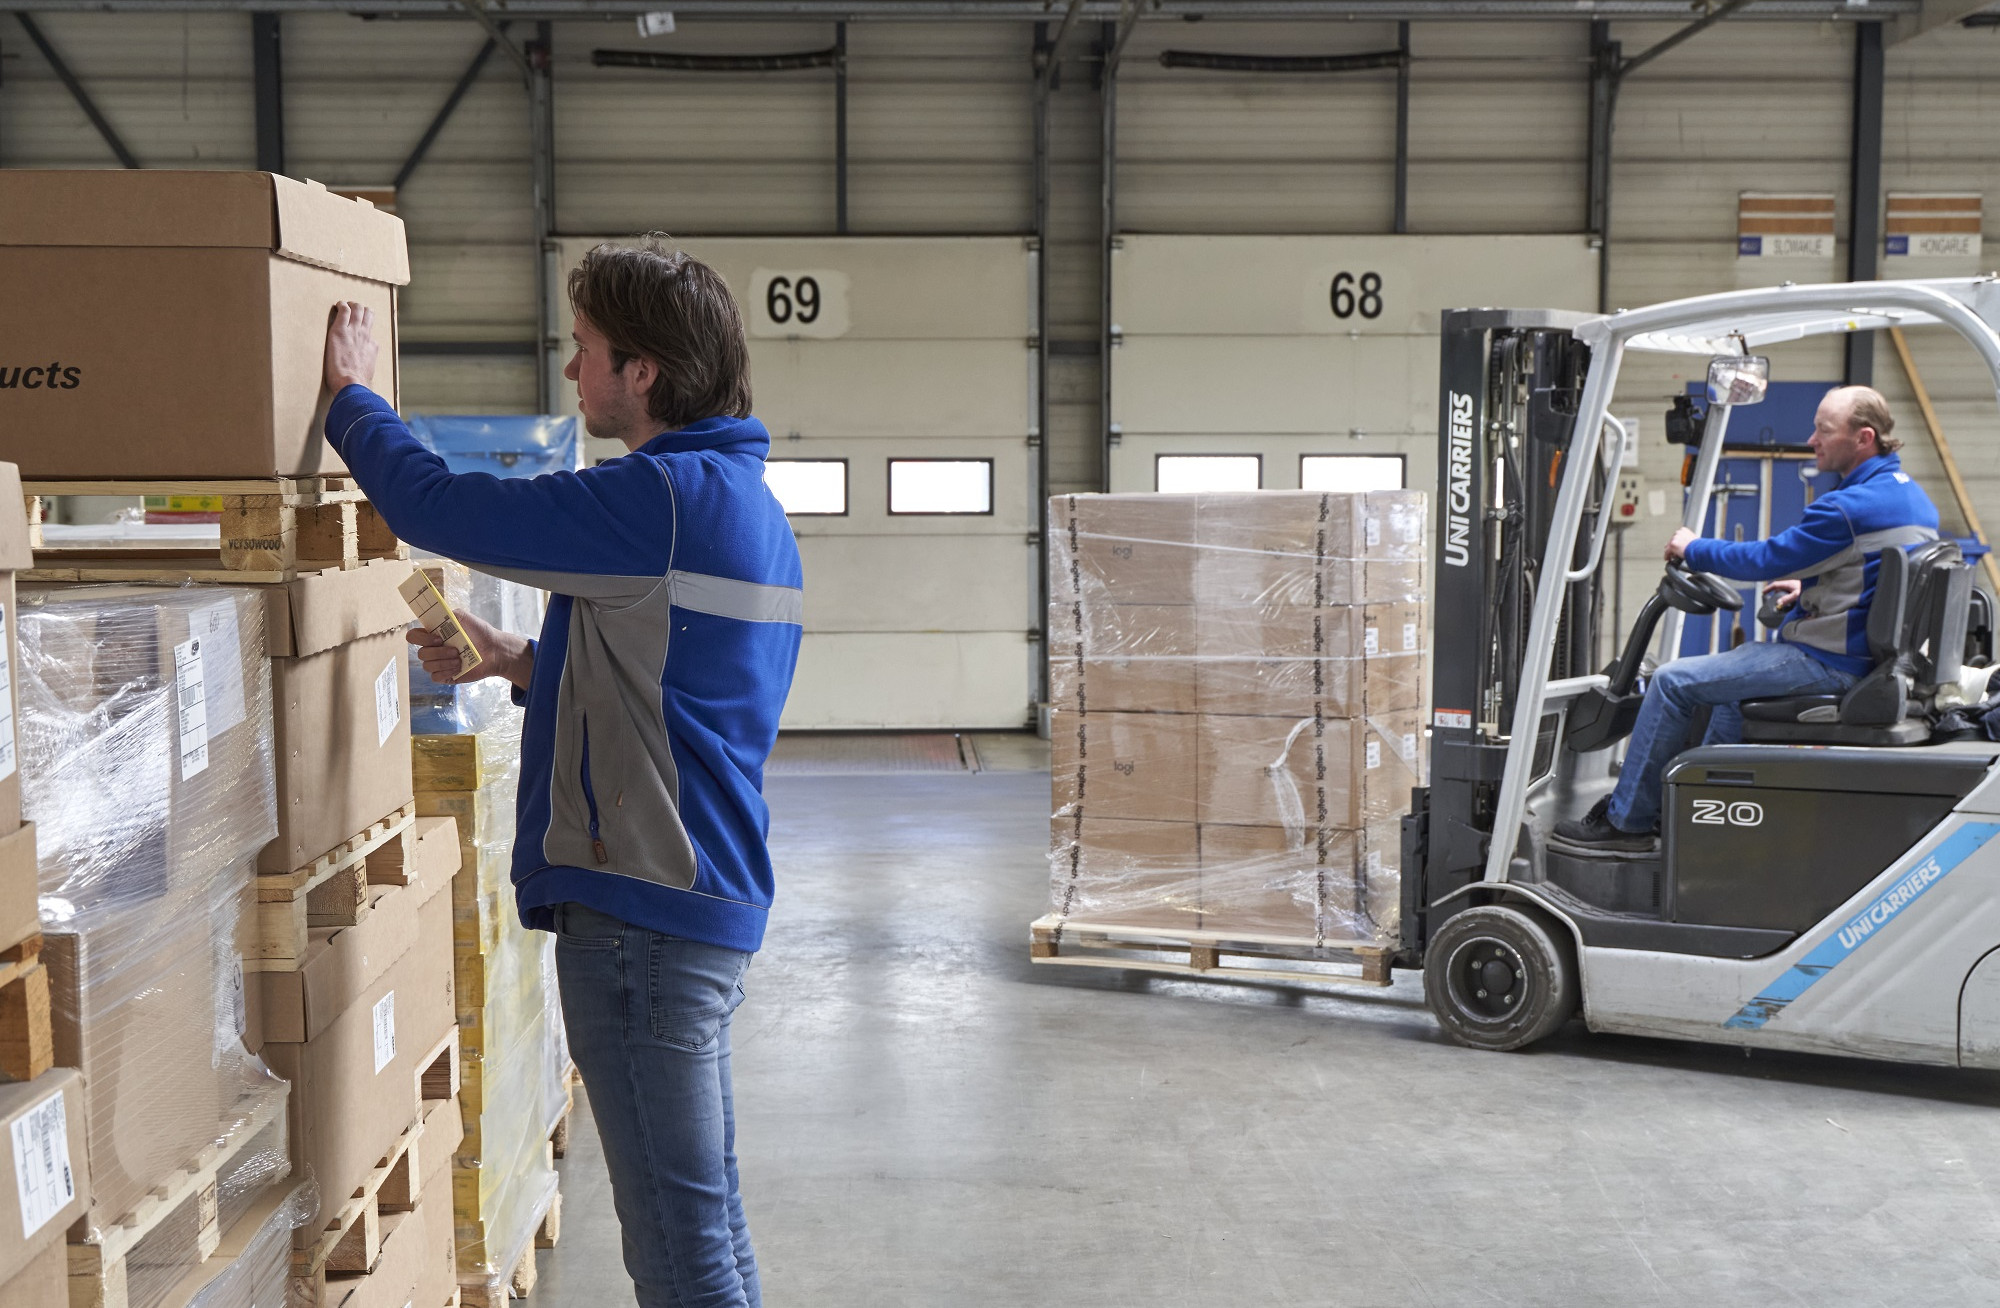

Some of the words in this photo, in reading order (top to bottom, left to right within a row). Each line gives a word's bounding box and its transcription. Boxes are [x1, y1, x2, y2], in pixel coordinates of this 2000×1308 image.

[767, 275, 820, 324] 69
[1329, 271, 1383, 319] 68
[1068, 518, 1078, 553] logitech
[1112, 545, 1133, 560] logi
[1070, 559, 1080, 594] logitech
[1314, 572, 1323, 609] logitech
[1072, 601, 1082, 636] logitech
[1313, 615, 1322, 652] logitech
[1074, 642, 1084, 677] logitech
[1313, 658, 1324, 695] logitech
[1077, 683, 1087, 718] logitech
[1314, 701, 1324, 738] logitech
[1077, 724, 1087, 759] logitech
[1114, 761, 1134, 776] logi
[1316, 744, 1326, 781] logitech
[1077, 765, 1087, 800] logitech
[1316, 786, 1327, 823] logitech
[1692, 800, 1763, 827] 20
[1074, 805, 1083, 840] logitech
[1070, 846, 1080, 880] logitech
[1316, 829, 1327, 865] logitech
[1063, 886, 1076, 917] logitech
[1316, 871, 1326, 907] logitech
